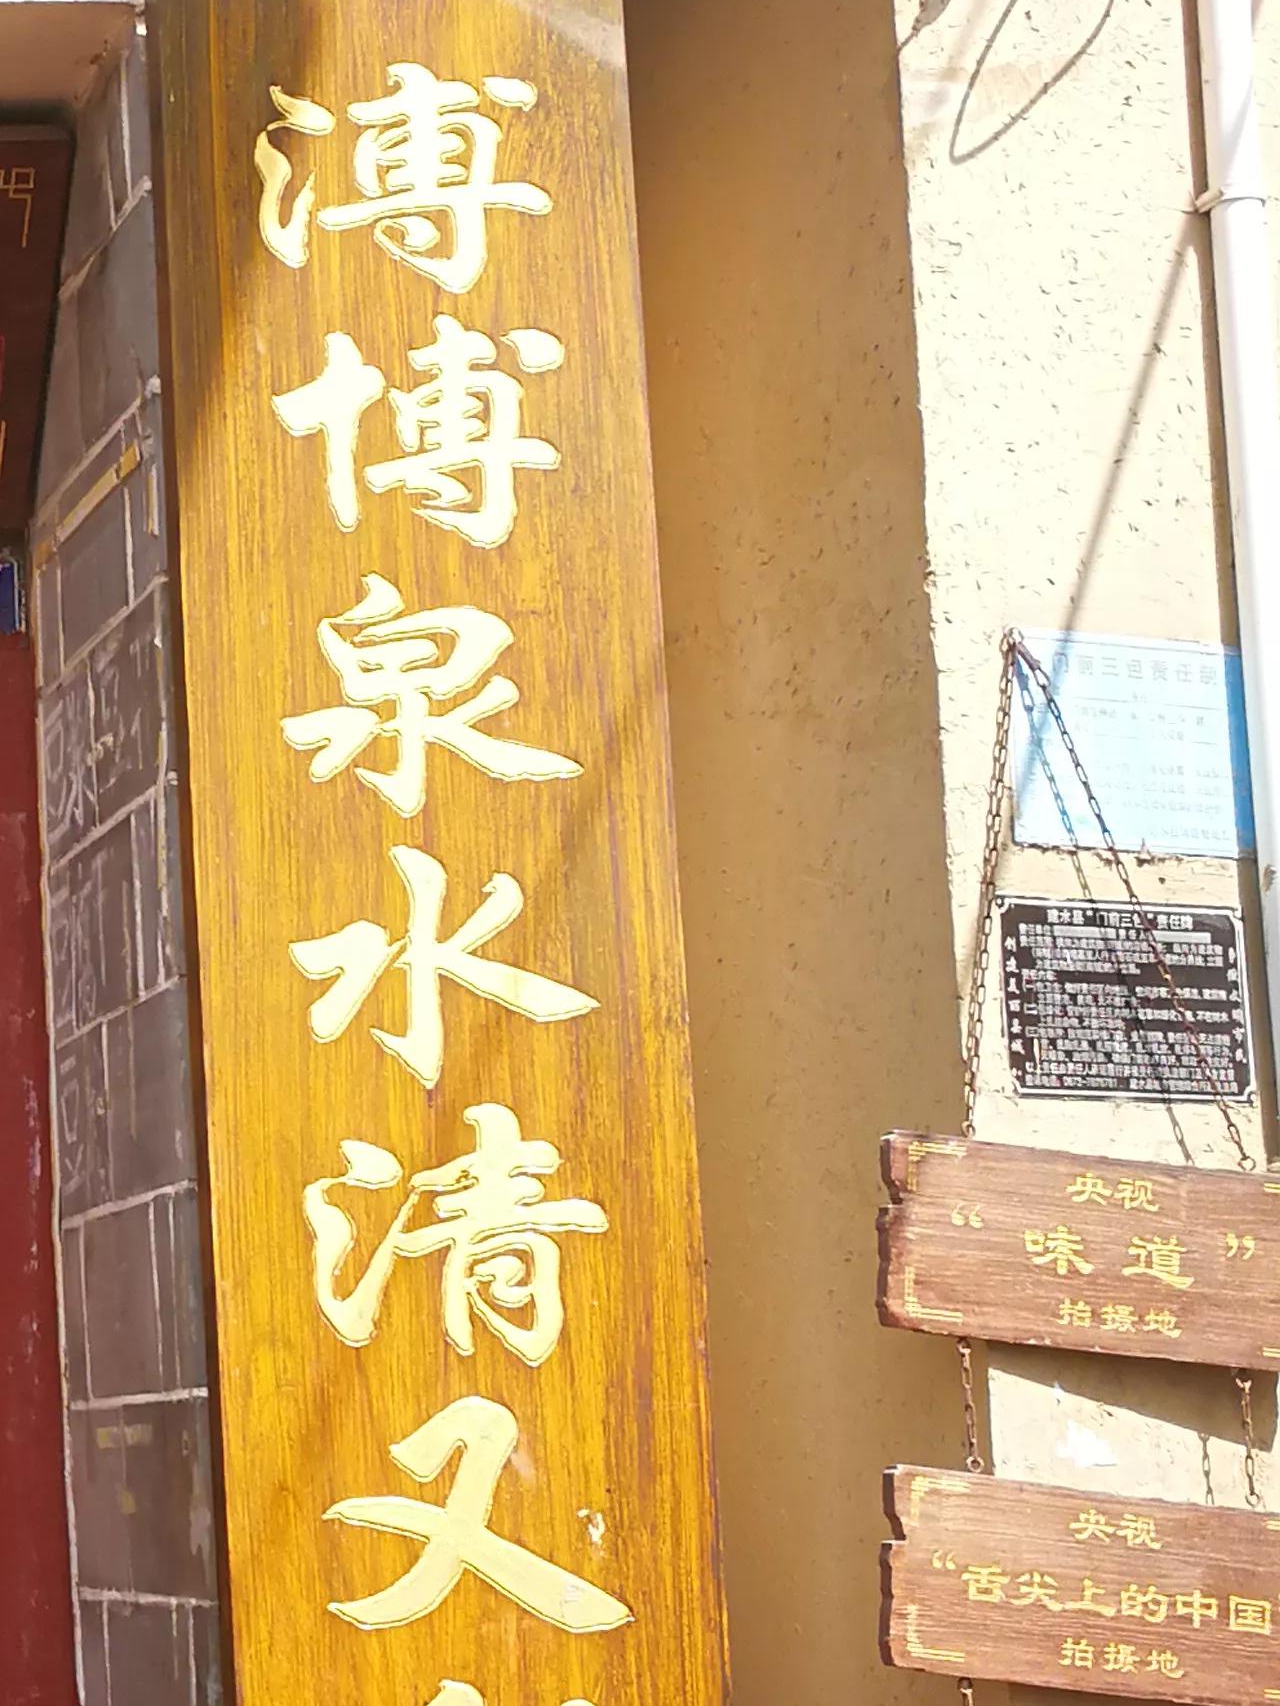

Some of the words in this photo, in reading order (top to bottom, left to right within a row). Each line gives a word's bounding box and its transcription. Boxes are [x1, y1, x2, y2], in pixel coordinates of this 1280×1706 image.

[1065, 1171, 1160, 1212] 央视
[1056, 1297, 1183, 1339] 拍摄地
[1069, 1508, 1163, 1550] 央视
[931, 1549, 1280, 1636] “舌尖上的中国
[1058, 1637, 1185, 1679] 拍摄地
